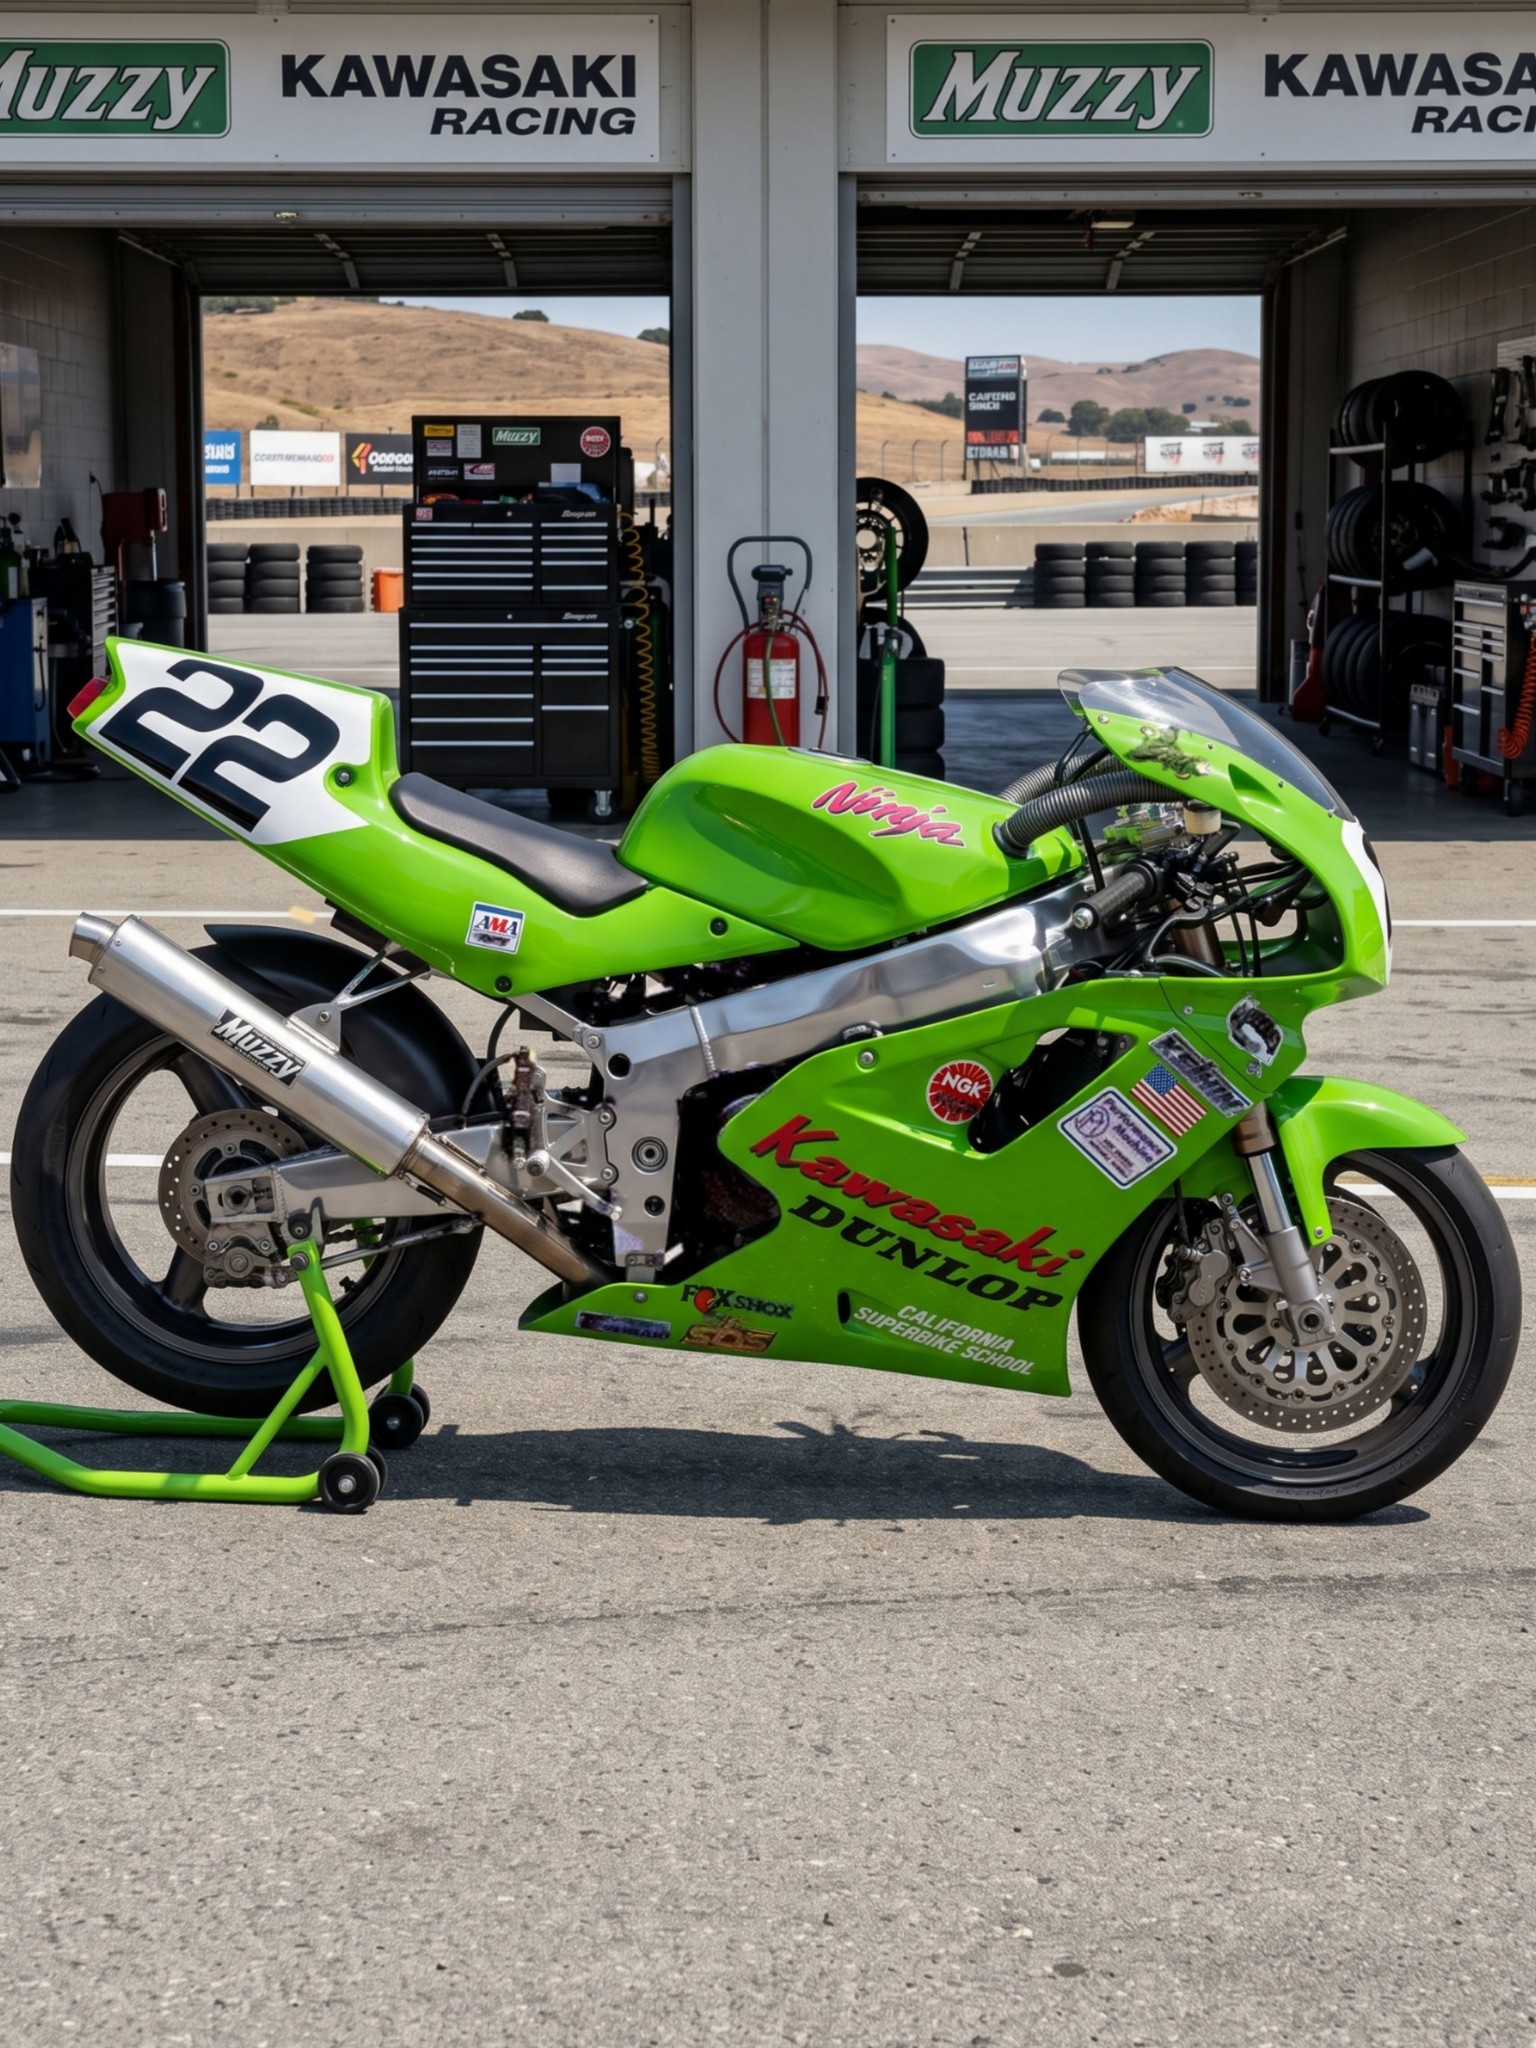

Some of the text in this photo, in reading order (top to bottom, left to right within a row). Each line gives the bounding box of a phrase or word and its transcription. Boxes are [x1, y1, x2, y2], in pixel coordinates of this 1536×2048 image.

[281, 54, 636, 98] KAWASAKI
[1265, 52, 1536, 97] KAWASA
[430, 107, 636, 135] RACING
[98, 659, 341, 832] 22
[812, 781, 965, 847] Ninja
[474, 915, 518, 935] AMA
[941, 1071, 986, 1099] NGK
[749, 1114, 1086, 1277] Kawasaki
[788, 1195, 1064, 1311] DUNLOP
[853, 1306, 1035, 1375] SUPERBIKE SCHOOL
[897, 1305, 1015, 1353] CALIFORNIA
